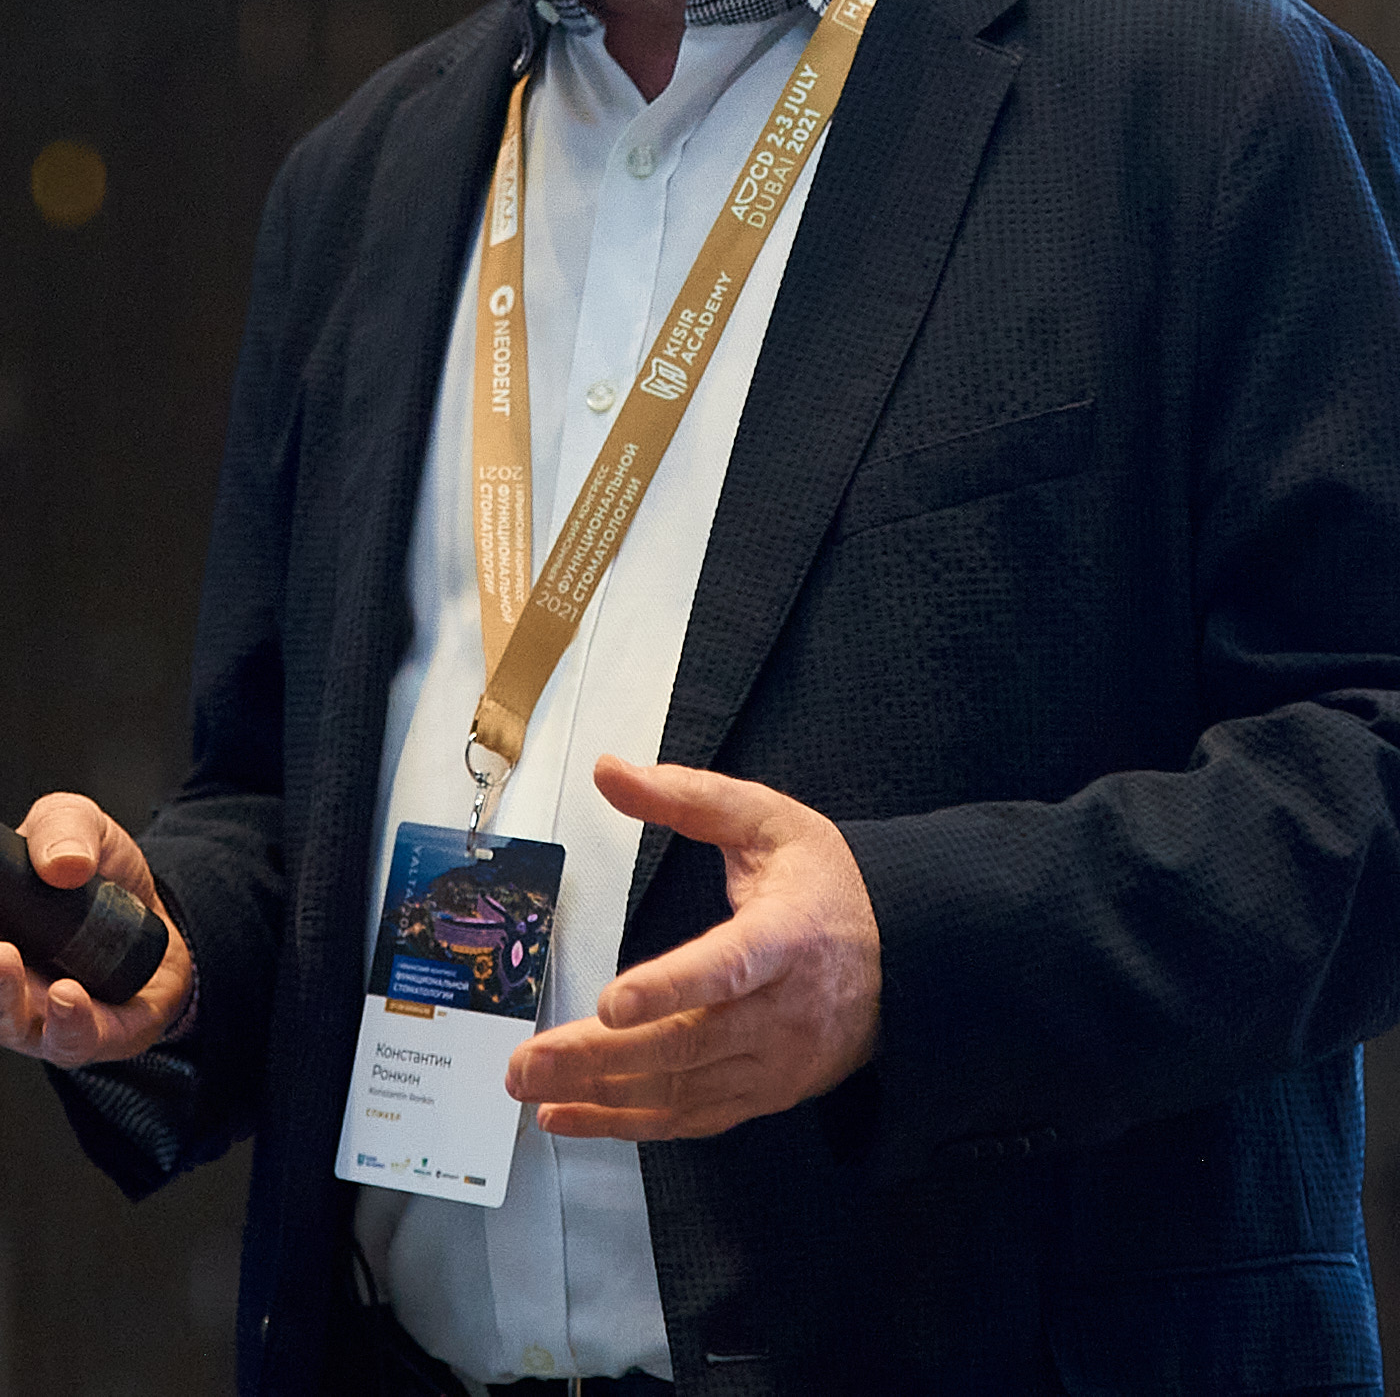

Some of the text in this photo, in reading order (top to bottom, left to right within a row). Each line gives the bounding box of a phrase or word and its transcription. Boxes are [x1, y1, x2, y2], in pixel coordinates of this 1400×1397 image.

[766, 112, 794, 148] 2-3
[784, 63, 820, 114] JULY
[747, 106, 821, 229] DUBAI 2021
[663, 308, 697, 358] KISIR
[681, 271, 732, 365] ACADEMY
[492, 320, 510, 416] NEODENT
[478, 483, 495, 594] СТОМАТОЛОГИИ
[496, 484, 514, 623] ФУНКЦИОНАЛЬНОЙ
[558, 442, 639, 593] ФУНКЦИОНАЛЬНОЙ
[573, 478, 641, 601] СТОМАТОЛОГИИ
[371, 1064, 421, 1086] Ронкин
[375, 1042, 452, 1069] Константин
